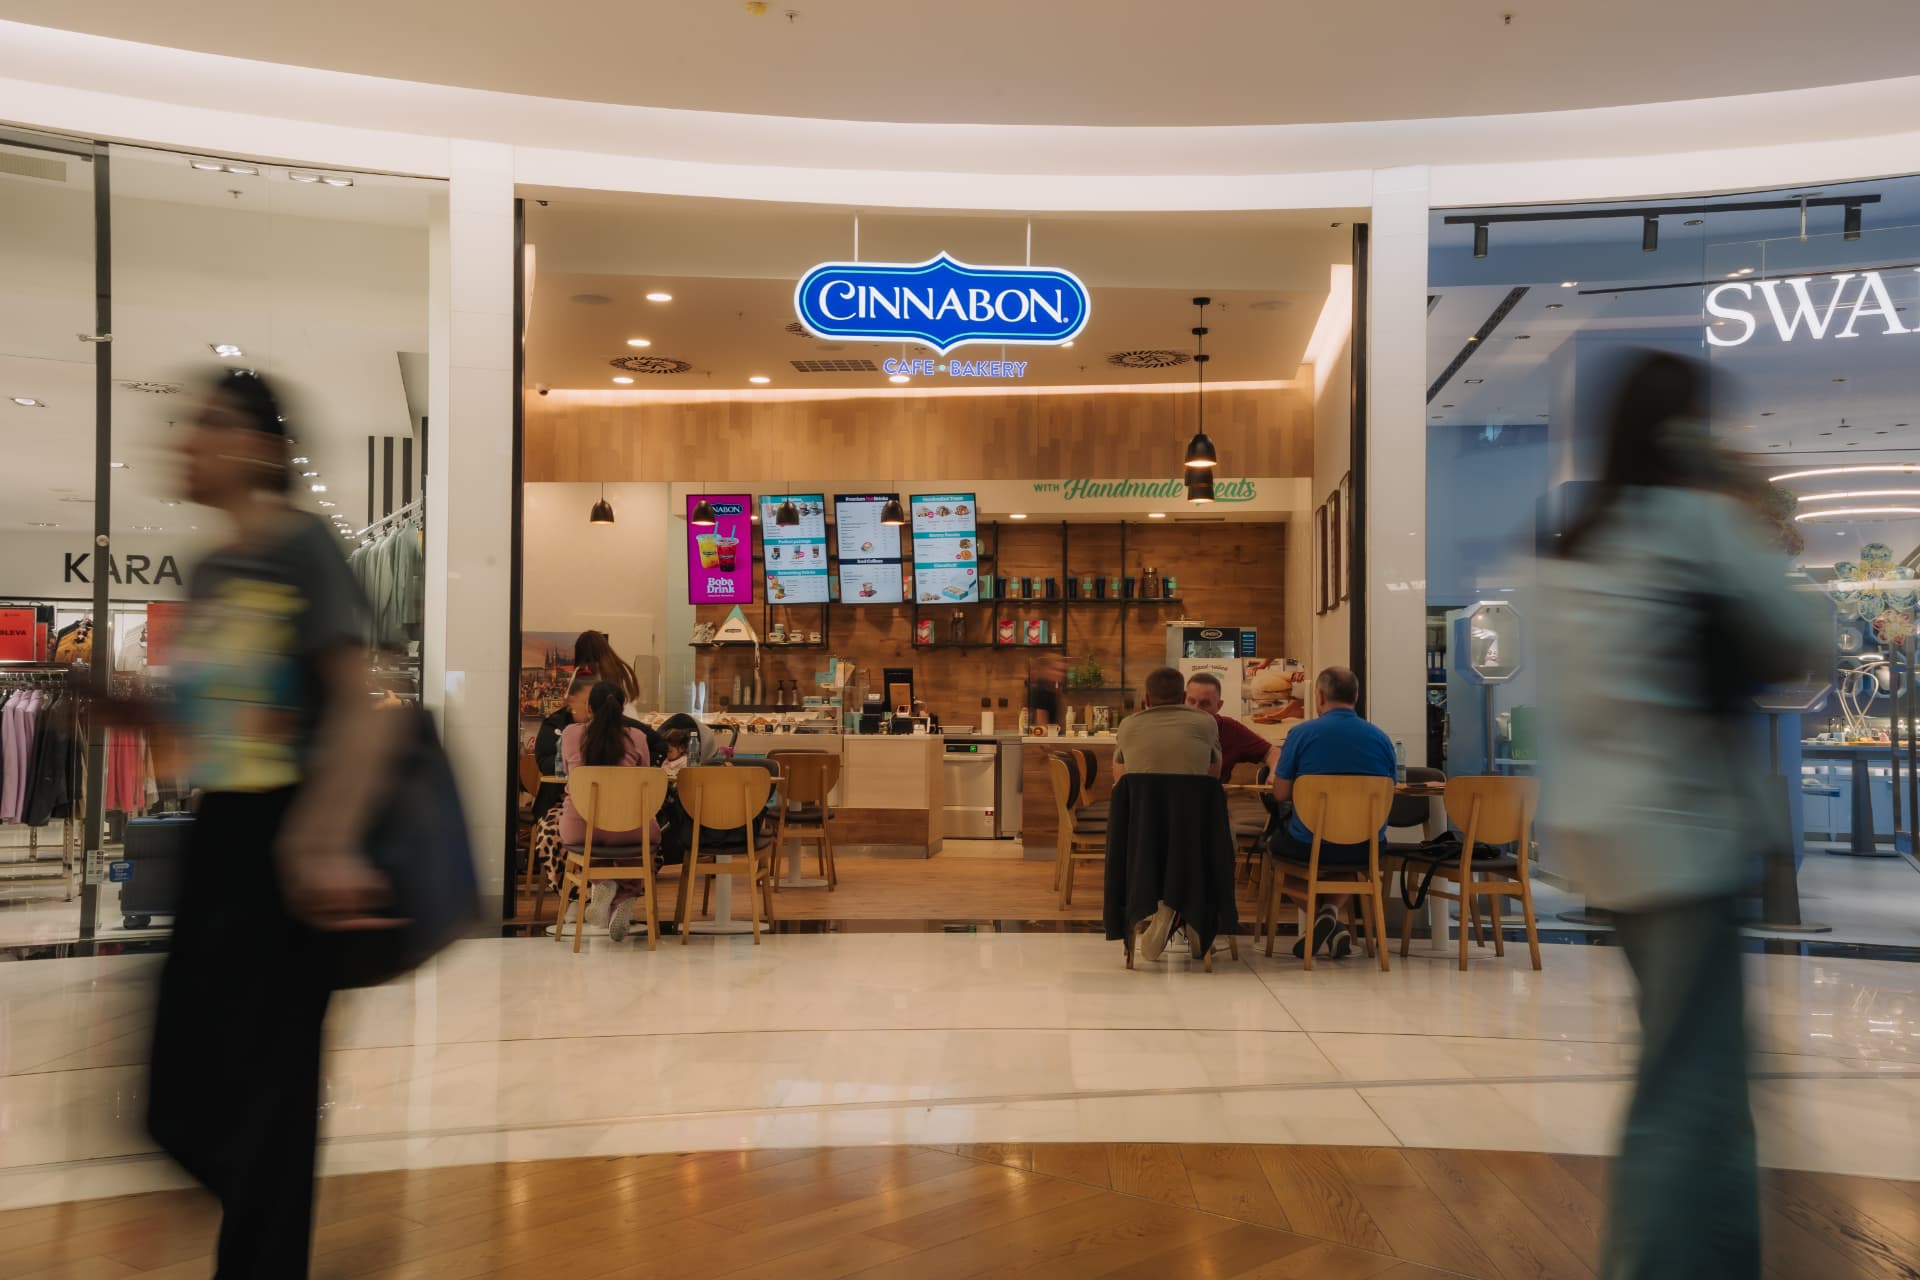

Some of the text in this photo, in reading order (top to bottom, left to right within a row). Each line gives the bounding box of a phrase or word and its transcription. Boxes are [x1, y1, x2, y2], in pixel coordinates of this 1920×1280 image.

[1706, 270, 1920, 347] SWA
[883, 358, 1028, 378] CAFE BAKERY
[1033, 484, 1060, 492] WITH
[1063, 479, 1183, 500] Handmade
[706, 585, 735, 593] Drink
[707, 577, 734, 585] Boba
